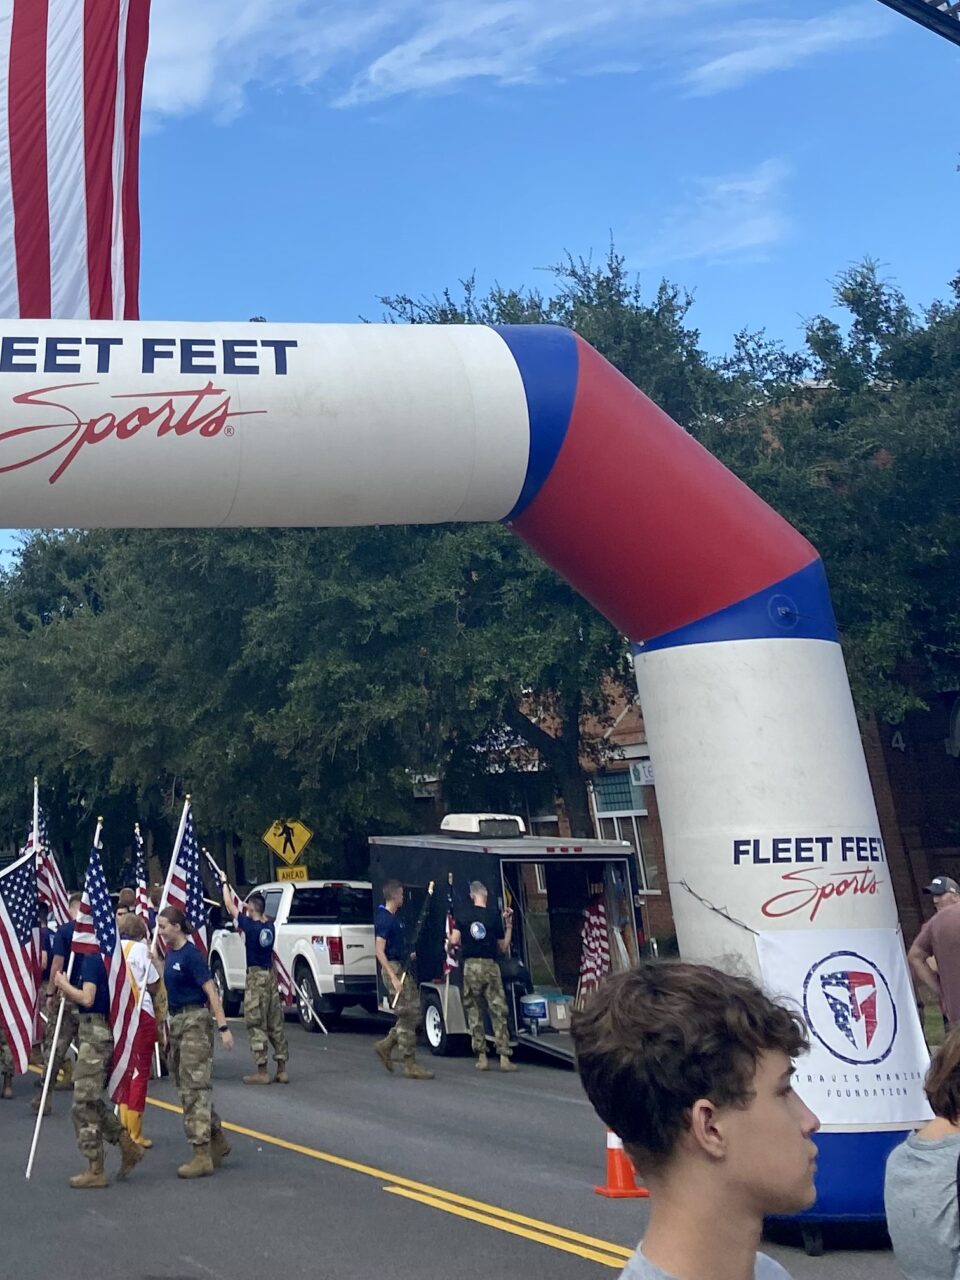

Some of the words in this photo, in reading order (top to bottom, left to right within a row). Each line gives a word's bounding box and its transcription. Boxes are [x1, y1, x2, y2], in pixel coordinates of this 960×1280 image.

[141, 338, 298, 375] FEET
[733, 837, 833, 865] FLEET
[281, 871, 305, 880] AHEAD
[761, 866, 884, 922] Sports
[795, 1073, 860, 1083] TRAVIS
[827, 1088, 908, 1098] FOUNDATION
